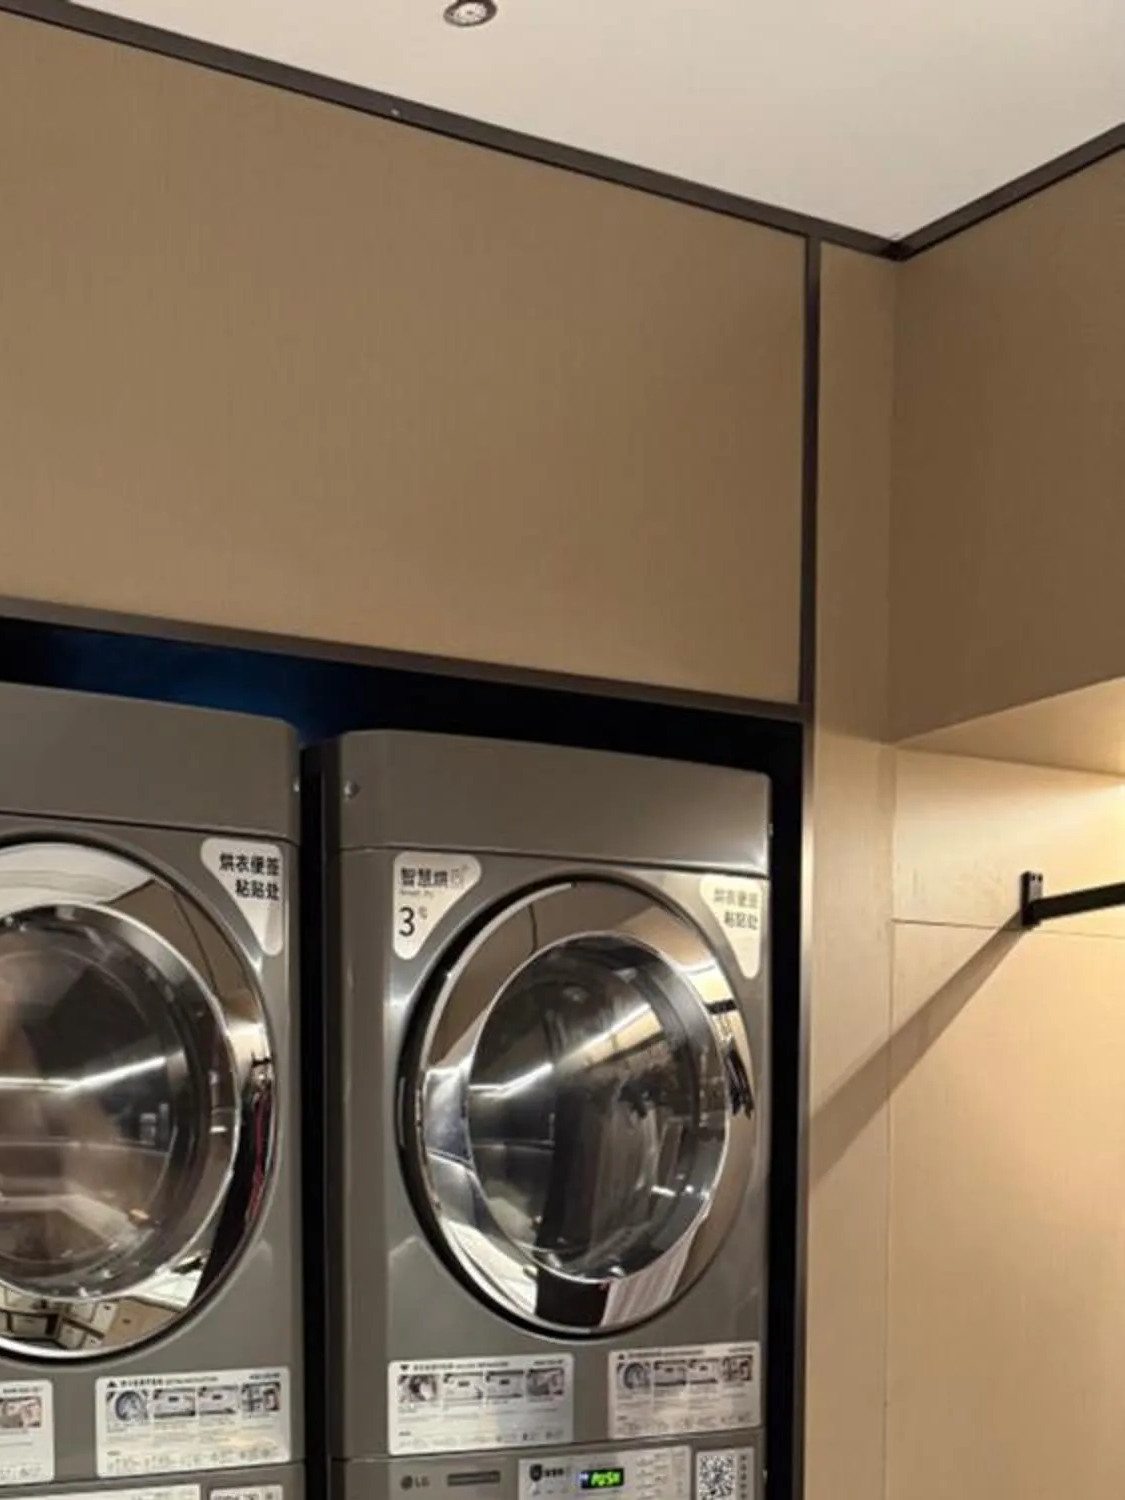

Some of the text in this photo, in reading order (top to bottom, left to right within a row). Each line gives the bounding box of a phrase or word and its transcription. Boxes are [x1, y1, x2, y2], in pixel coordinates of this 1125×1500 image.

[219, 853, 279, 876] 烘衣便签
[236, 879, 279, 901] 粘贴处
[592, 1473, 622, 1486] PUSH
